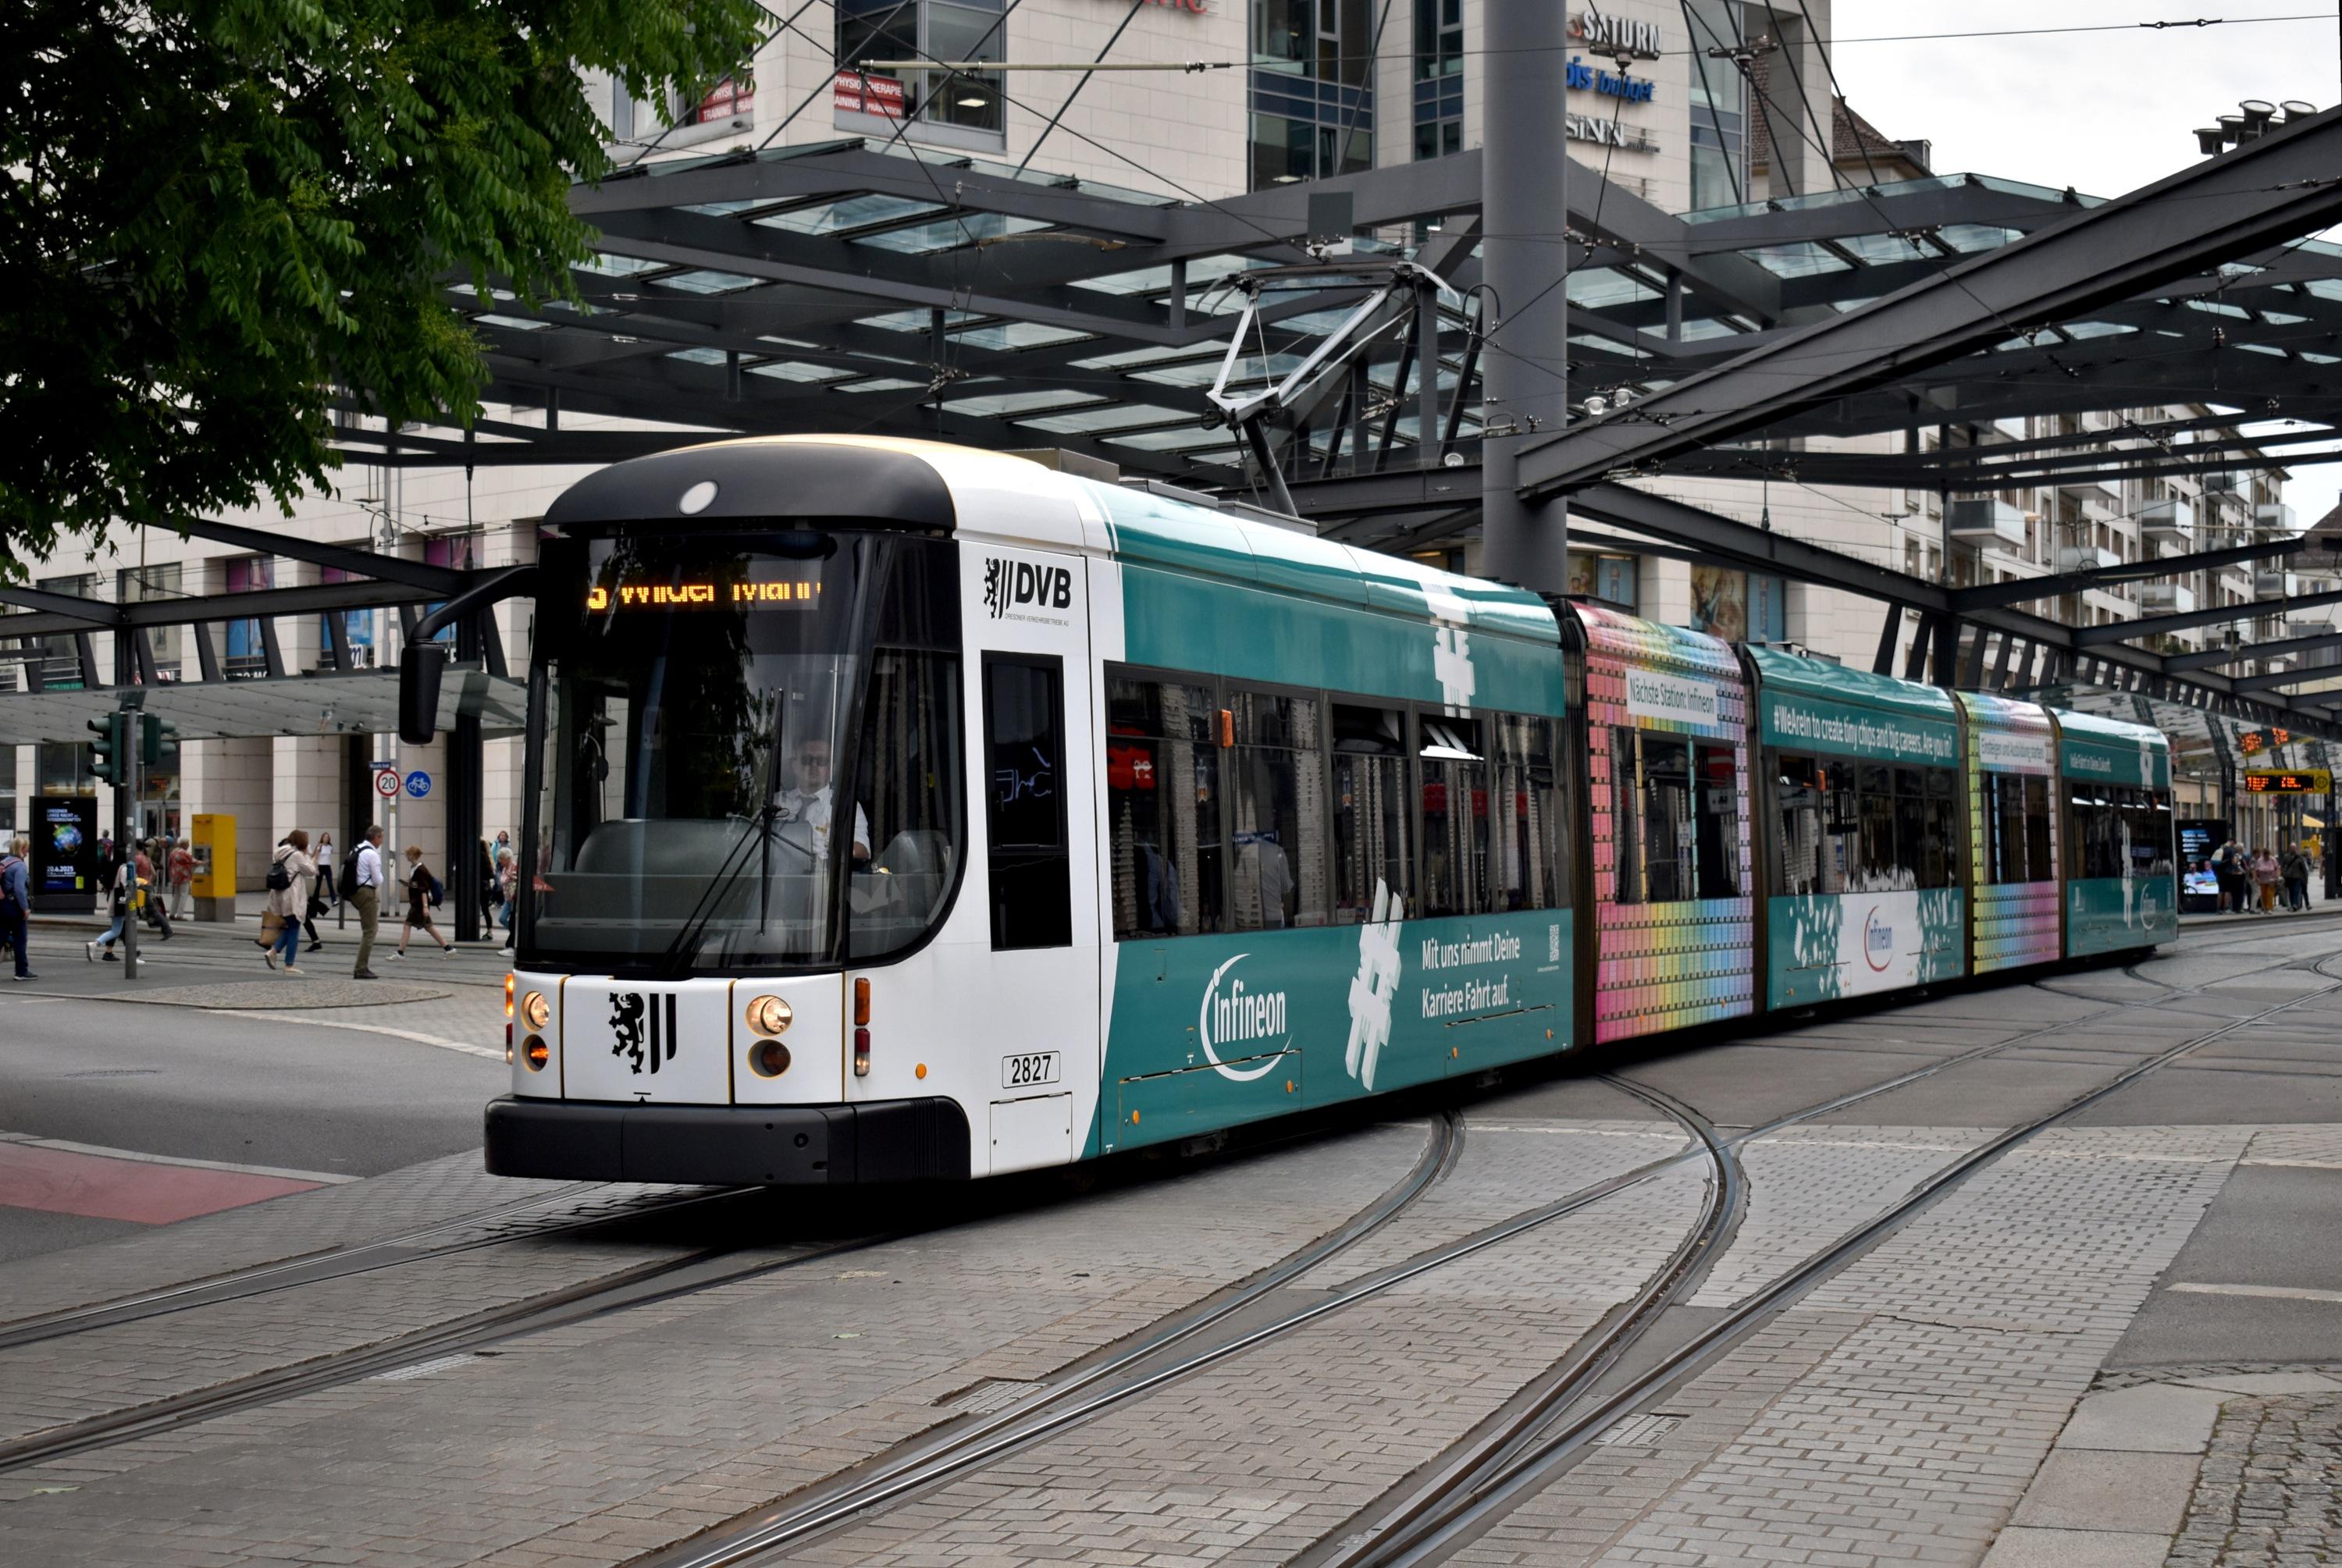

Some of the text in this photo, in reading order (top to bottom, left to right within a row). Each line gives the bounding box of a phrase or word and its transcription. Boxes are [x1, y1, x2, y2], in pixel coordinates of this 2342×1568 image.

[1582, 11, 1662, 52] SATURN
[1598, 70, 1655, 105] budget
[1014, 561, 1071, 610] DVB
[1630, 677, 1715, 714] Nächste Station: Infineon
[1774, 705, 1812, 738] #WeAreIn
[1812, 711, 1821, 739] to
[1821, 715, 1844, 743] create
[1844, 715, 1858, 752] tiny
[1876, 722, 1888, 749] and
[382, 777, 396, 790] 20
[1422, 930, 1520, 970] Mit uns nimmt Deine
[1214, 968, 1286, 1044] Infineon
[1422, 973, 1509, 1019] Karriere Fahrt auf.
[1012, 1054, 1052, 1084] 2827
